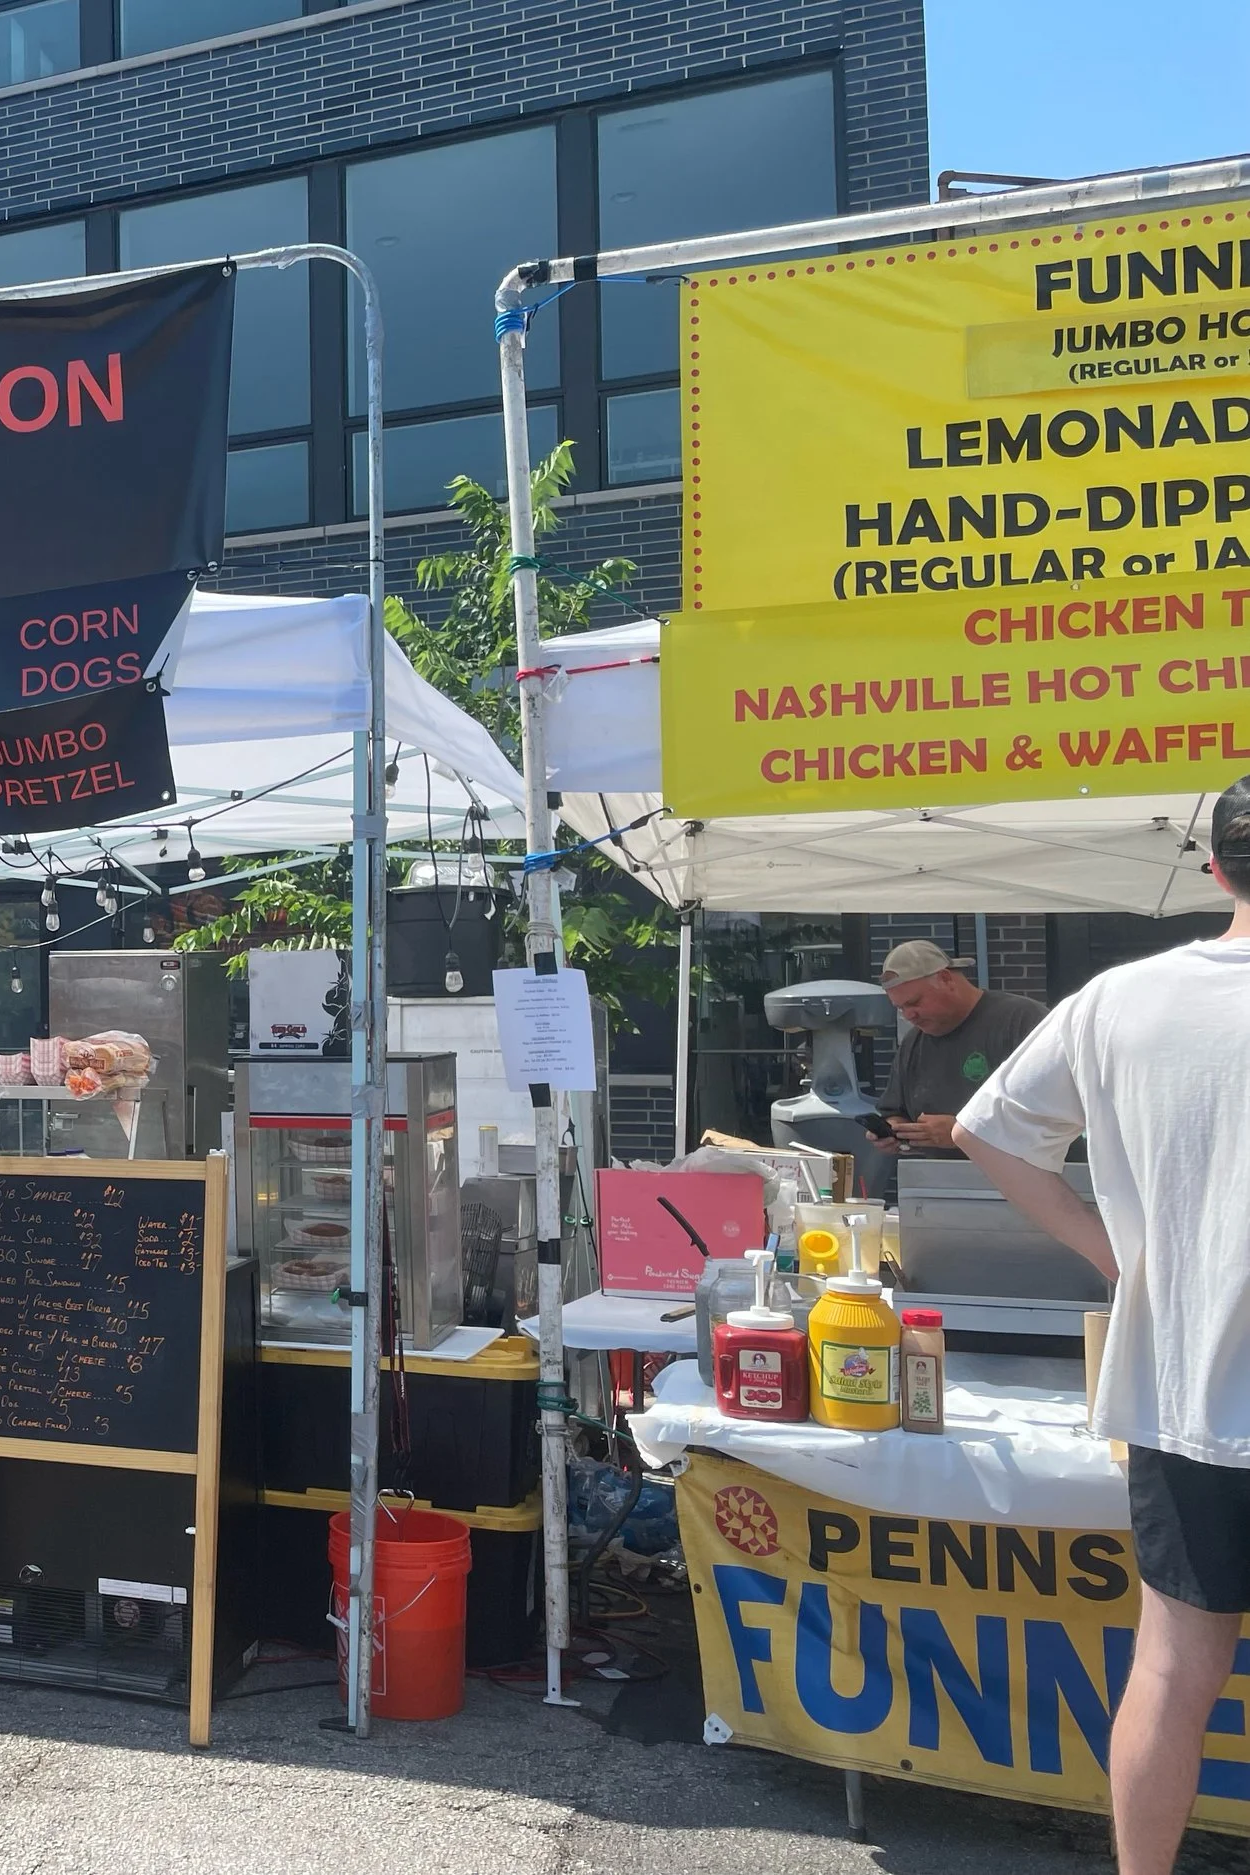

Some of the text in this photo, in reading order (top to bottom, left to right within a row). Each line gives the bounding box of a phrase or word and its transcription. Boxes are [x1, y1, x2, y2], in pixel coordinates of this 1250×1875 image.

[1034, 241, 1250, 311] FUNN
[1052, 315, 1186, 358] JUMBO
[1068, 354, 1207, 385] (REGULAR
[1214, 353, 1240, 370] or
[833, 546, 1106, 600] (REGULAR
[1122, 551, 1175, 576] or
[964, 592, 1204, 646] CHICKEN
[19, 604, 139, 651] CORN
[22, 653, 142, 697] DOGS
[734, 672, 1012, 723] NASHVILLE
[1028, 663, 1141, 704] HOT
[760, 737, 988, 785] CHICKEN
[1005, 735, 1043, 771] &
[21, 1182, 73, 1203] SAMPLER
[11, 1207, 42, 1223] SLAB
[138, 1216, 168, 1230] WATER
[22, 1229, 53, 1245] SLAB
[137, 1229, 159, 1243] SODA
[22, 1251, 57, 1266] SUNDAE
[24, 1269, 42, 1286] PORK
[645, 1264, 680, 1279] Powdered
[64, 1298, 84, 1311] BEEF
[17, 1324, 43, 1339] FRIES
[71, 1354, 106, 1366] CHEESE
[742, 1372, 779, 1382] KETCHUP
[56, 1386, 93, 1399] CHEESE
[1, 1394, 19, 1408] DOG
[807, 1508, 1130, 1602] PENNS
